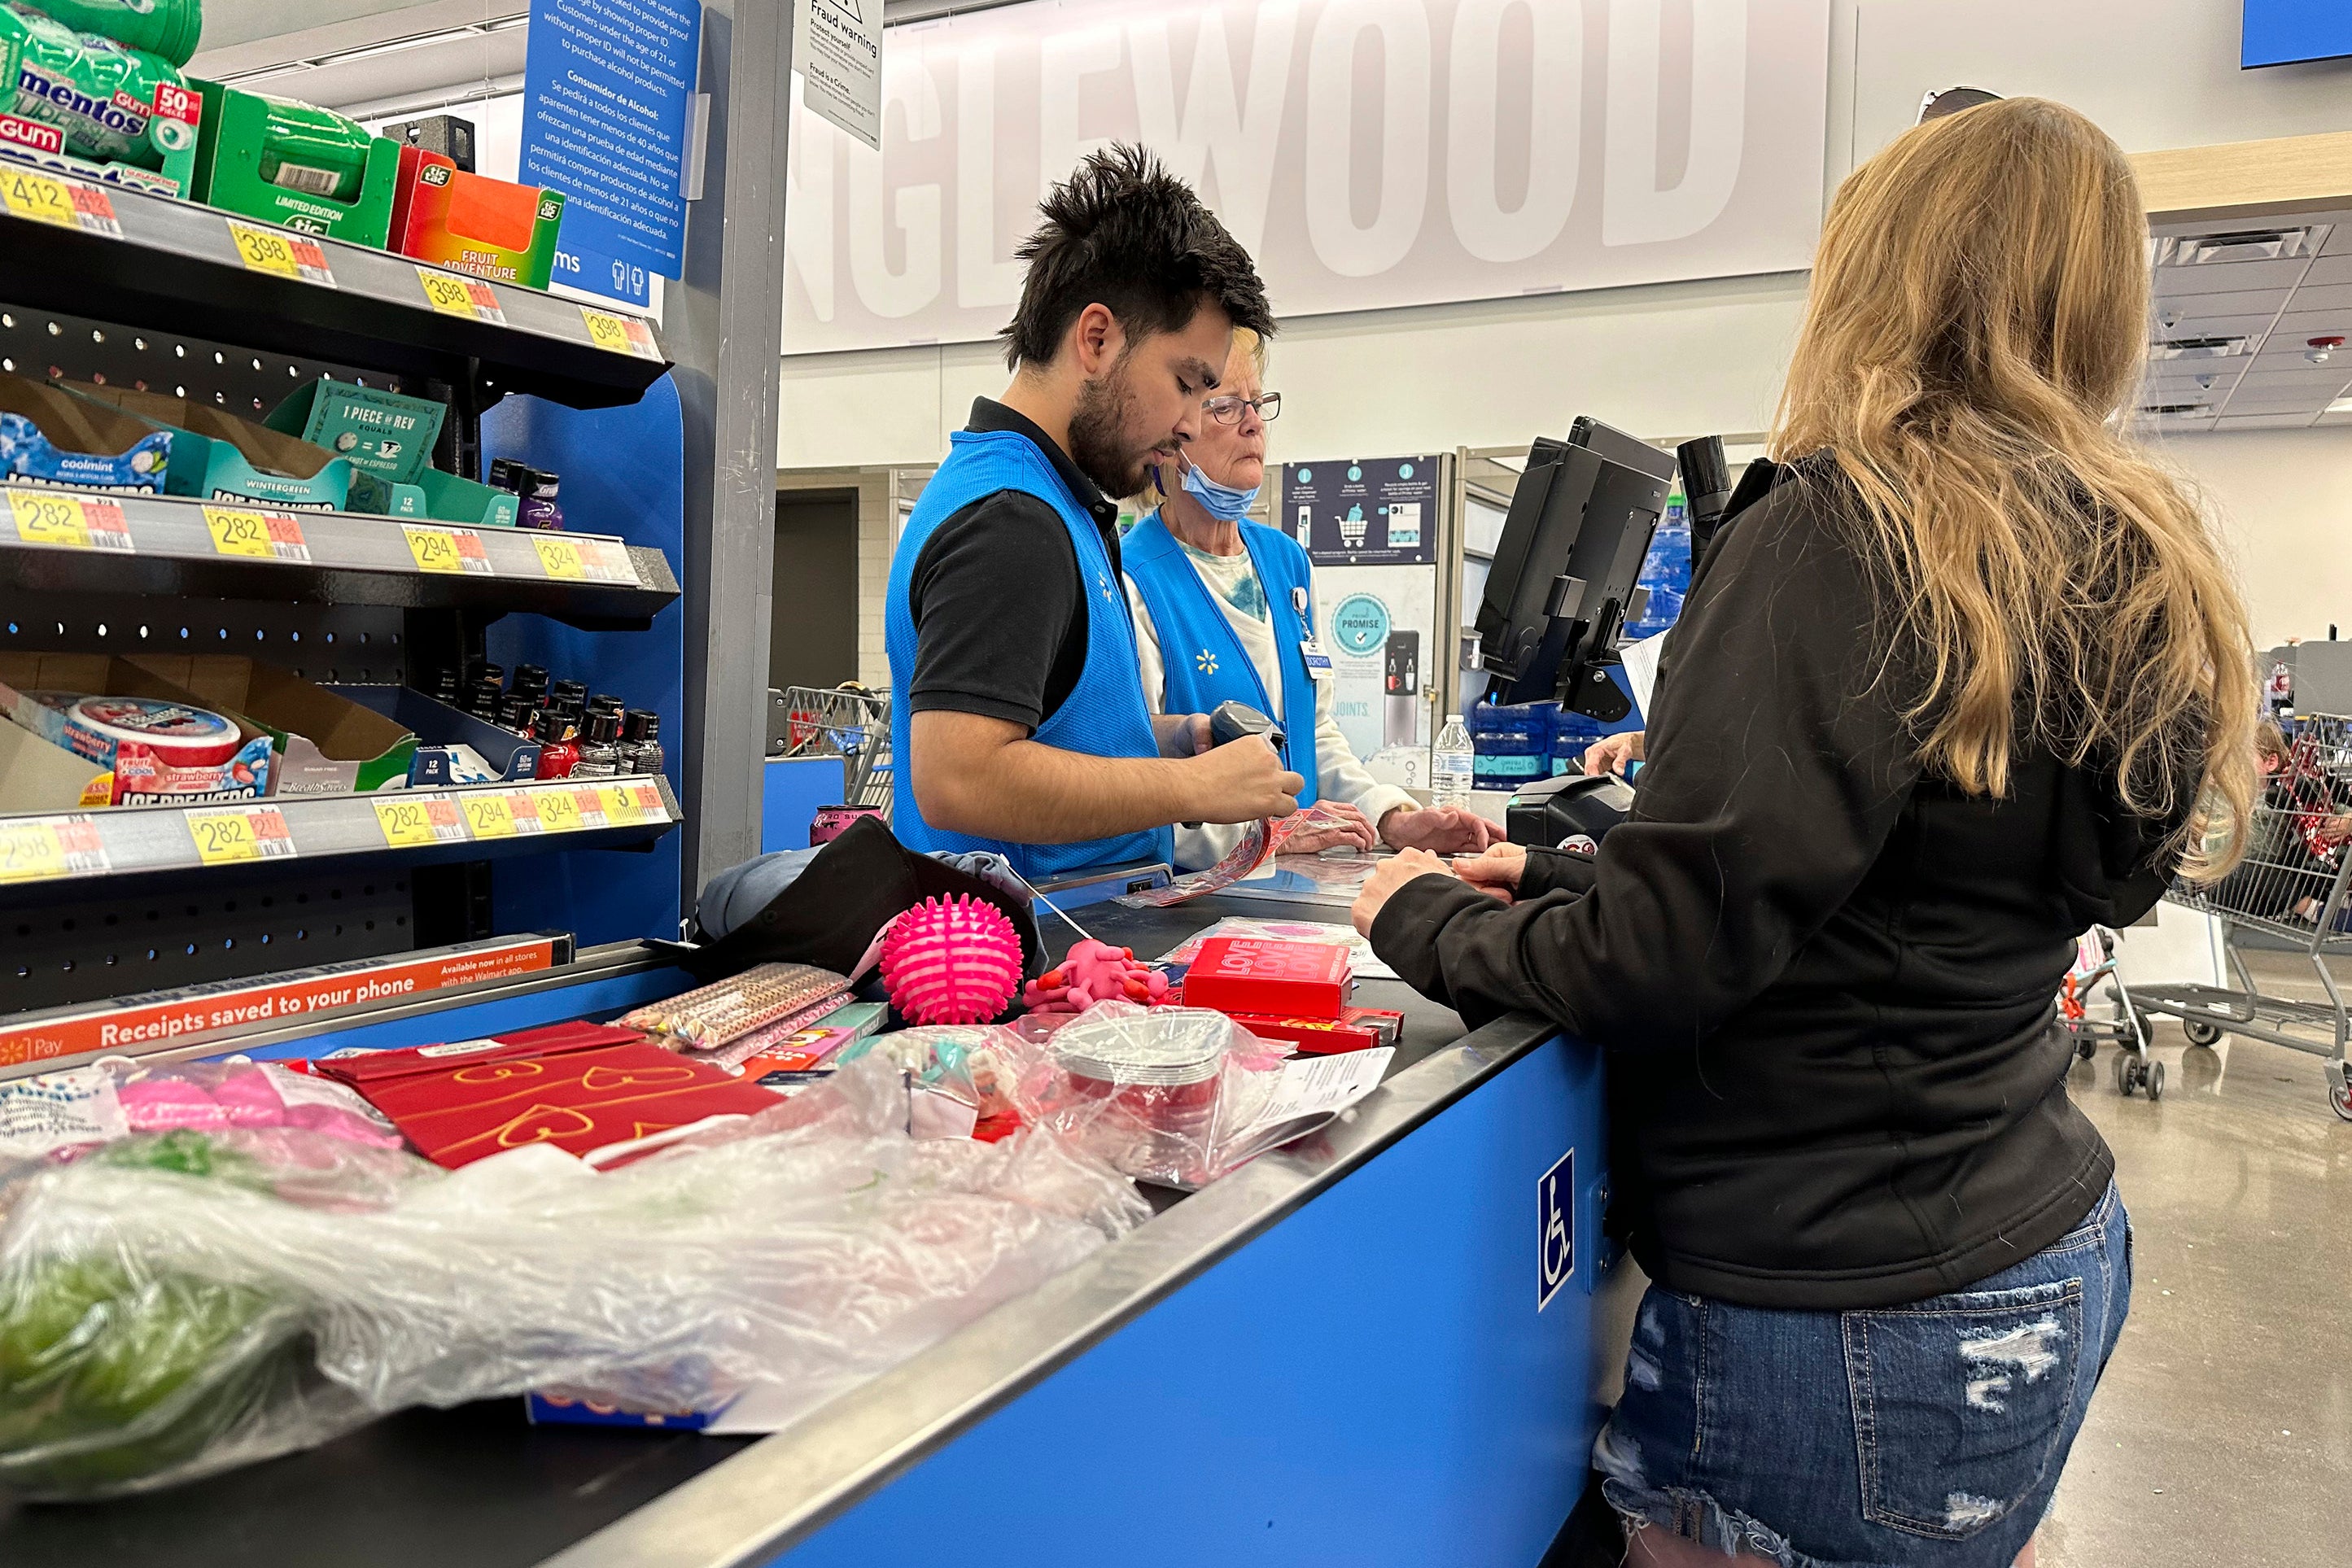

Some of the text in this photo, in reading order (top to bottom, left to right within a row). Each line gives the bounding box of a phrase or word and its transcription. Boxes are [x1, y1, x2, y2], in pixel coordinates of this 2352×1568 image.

[592, 2, 669, 47] by showing proper ID.
[633, 6, 688, 40] to provide proof
[658, 4, 690, 26] under the
[557, 0, 597, 27] Customers
[599, 24, 620, 38] under
[623, 34, 634, 46] the
[635, 42, 648, 54] age
[658, 53, 666, 63] 21
[811, 1, 838, 28] Fraud
[841, 21, 877, 59] warning
[811, 18, 851, 51] Protect yourself.
[544, 13, 684, 89] without proper ID will not be permitted
[562, 39, 667, 97] to purchase alcohol products.
[810, 62, 824, 79] Fraud
[833, 78, 851, 95] Crime.
[18, 68, 146, 136] mentos
[115, 91, 151, 119] GUM
[160, 86, 188, 110] 50
[567, 71, 658, 120] Consumidor de Alcohol:
[552, 81, 561, 91] Se
[563, 88, 587, 103] pedirá
[594, 102, 615, 116] todos
[617, 111, 627, 122] los
[628, 117, 654, 134] clientes
[656, 132, 669, 142] que
[0, 118, 58, 151] GUM
[539, 94, 678, 162] aparenten tener menos de 40 años que
[537, 111, 677, 177] ofrezcan una prueba de edad mediante
[430, 166, 448, 179] tic
[545, 133, 559, 144] una
[562, 140, 610, 166] identificación
[612, 162, 648, 182] adecuada.
[649, 177, 659, 186] No
[425, 172, 446, 186] tac
[531, 145, 566, 164] permitirá
[567, 160, 599, 177] comprar
[600, 174, 636, 194] productos
[638, 189, 647, 198] de
[648, 194, 672, 207] alcohol
[528, 159, 540, 171] los
[541, 166, 570, 183] clientes
[572, 178, 582, 188] de
[584, 184, 609, 199] menos
[610, 194, 619, 203] de
[620, 198, 628, 207] 21
[630, 203, 647, 214] años
[654, 213, 667, 223] que
[275, 195, 343, 221] LIMITED EDITION
[540, 207, 555, 219] tac
[544, 202, 557, 212] tic
[567, 195, 667, 238] una identificación adecuada.
[444, 260, 518, 280] ADVENTURE
[461, 250, 499, 265] FRUIT
[343, 405, 350, 418] 1
[350, 407, 383, 424] PIECE
[393, 415, 416, 430] REV
[358, 424, 393, 435] EQUALS
[61, 458, 114, 473] coolmint
[369, 459, 398, 470] ESPRESSO
[246, 479, 312, 495] WINTERGREEN
[403, 497, 413, 507] 12
[1342, 619, 1379, 629] PROMISE
[1306, 657, 1330, 667] DOROTHY
[428, 759, 439, 769] 12
[165, 771, 224, 784] strawberry
[614, 785, 629, 807] 3
[440, 951, 538, 976] Available now in all stores
[1216, 940, 1262, 976] LOVE
[1250, 941, 1295, 977] LOVE
[440, 966, 525, 989] with the Walmart app.
[100, 977, 414, 1048] Receipts saved to your phone
[35, 1037, 63, 1059] Pay
